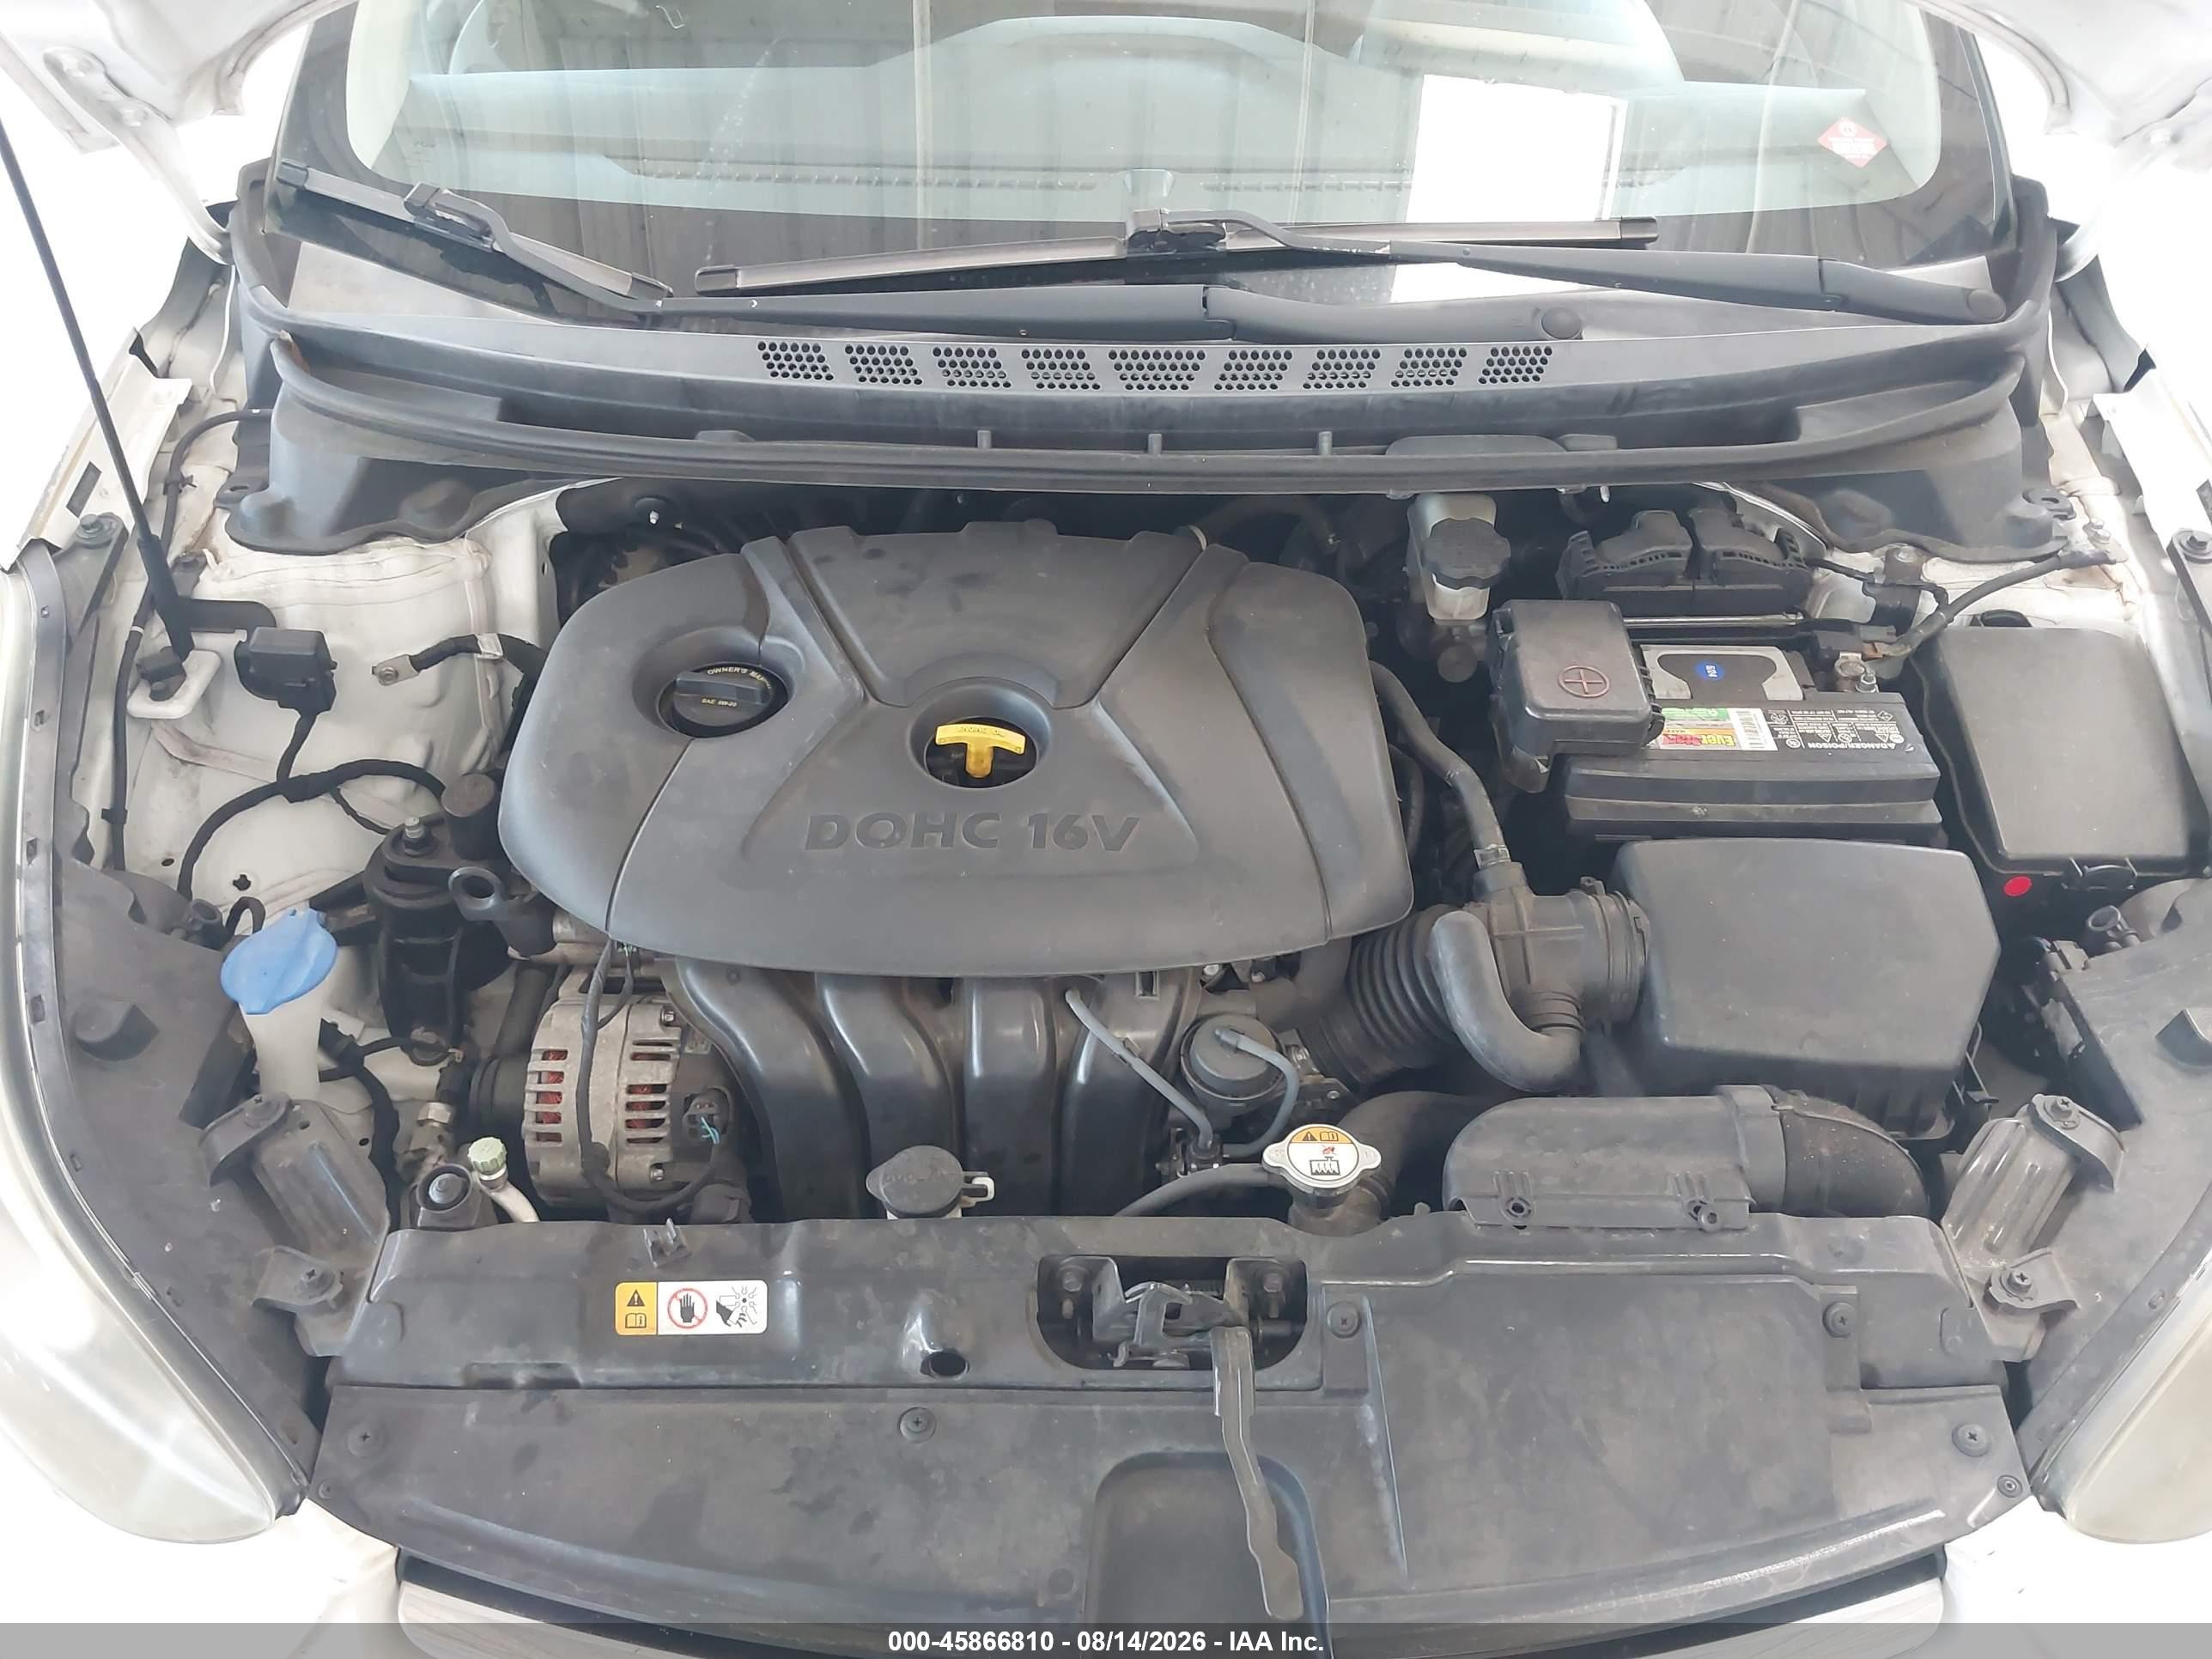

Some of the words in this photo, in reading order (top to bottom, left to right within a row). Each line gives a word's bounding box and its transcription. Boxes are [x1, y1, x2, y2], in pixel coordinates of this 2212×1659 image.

[707, 666, 748, 675] OWNER'S
[804, 811, 1003, 851] DOHC
[1028, 811, 1140, 852] 16V
